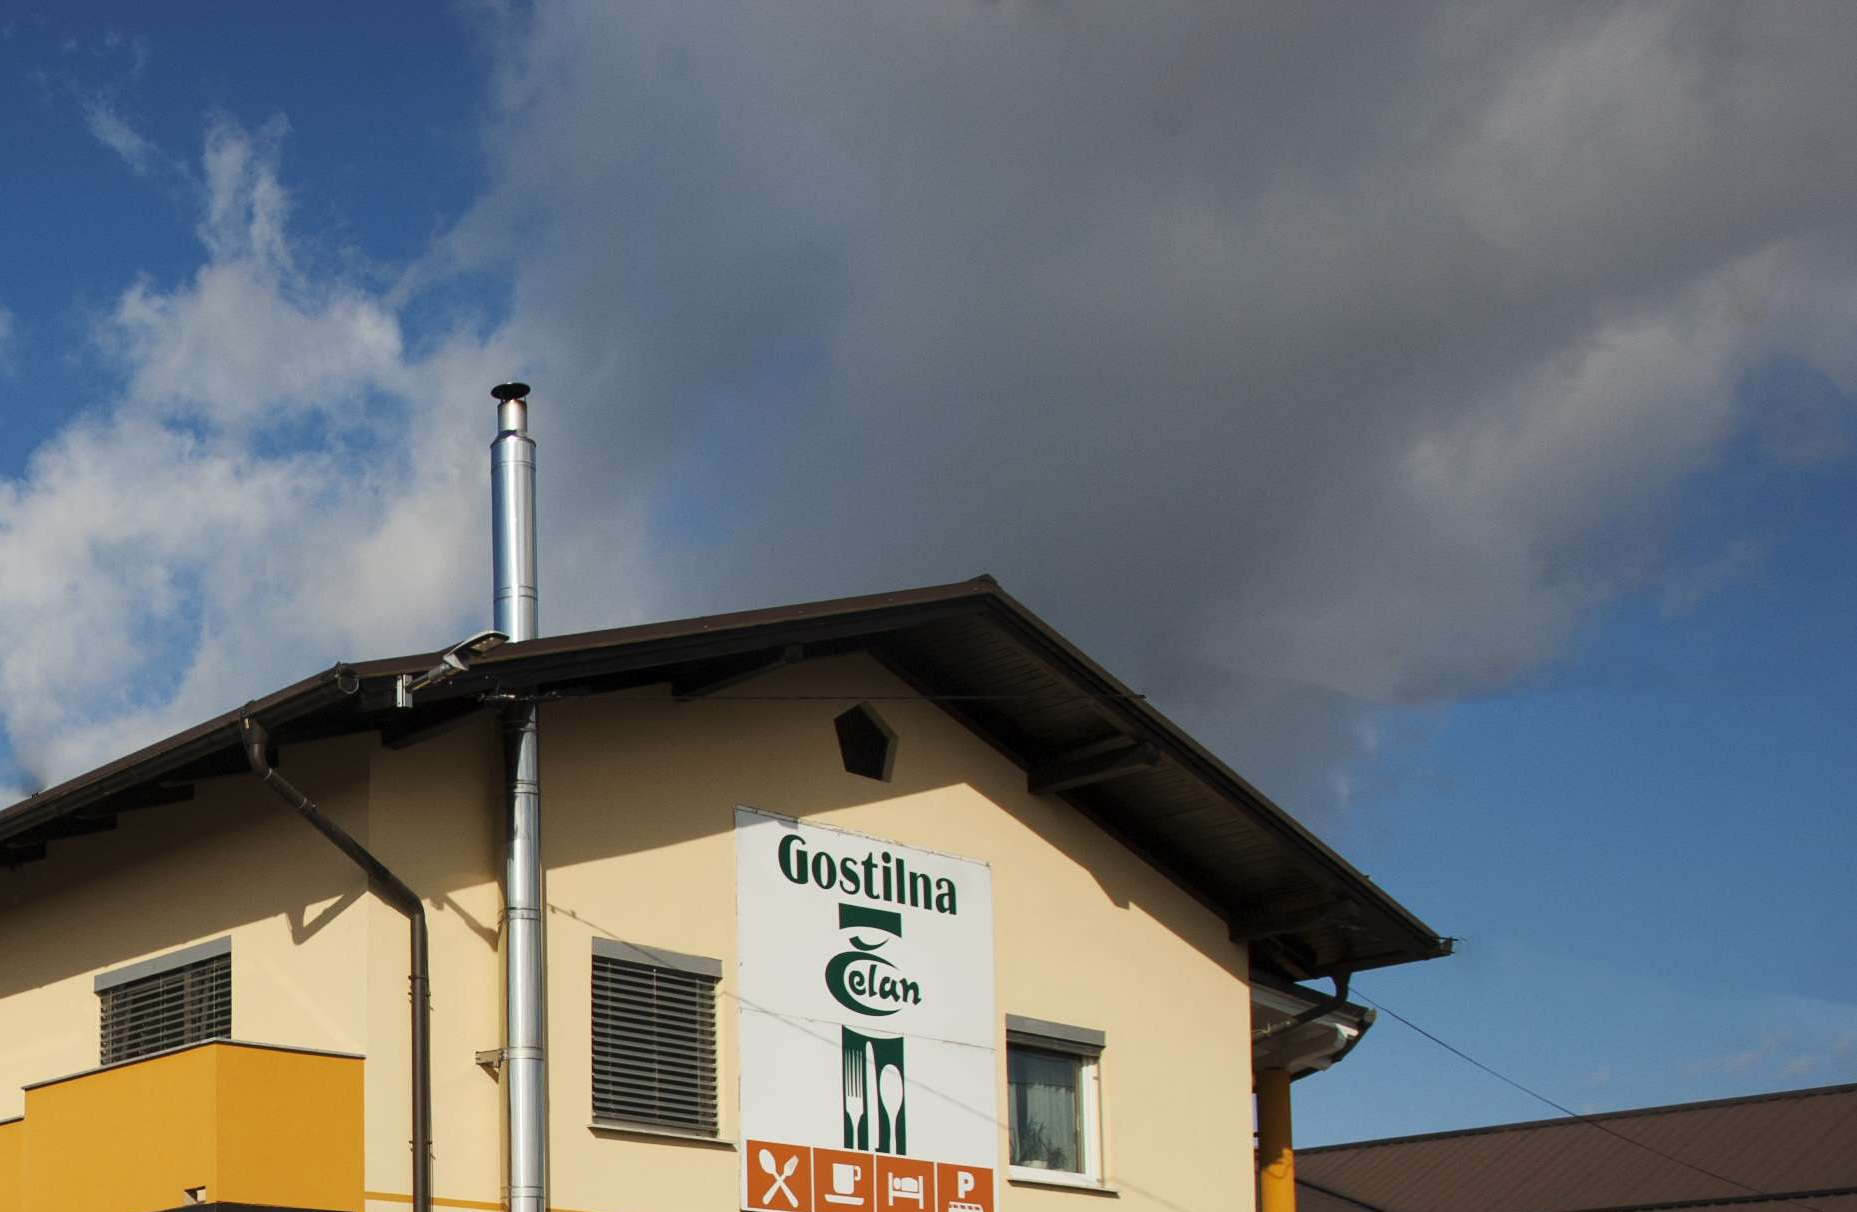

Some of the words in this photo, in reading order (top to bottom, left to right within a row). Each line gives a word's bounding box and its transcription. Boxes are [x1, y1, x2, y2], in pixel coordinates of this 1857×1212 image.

[777, 834, 958, 915] Gostilna
[825, 935, 922, 1017] Čelan
[957, 1170, 975, 1199] P
